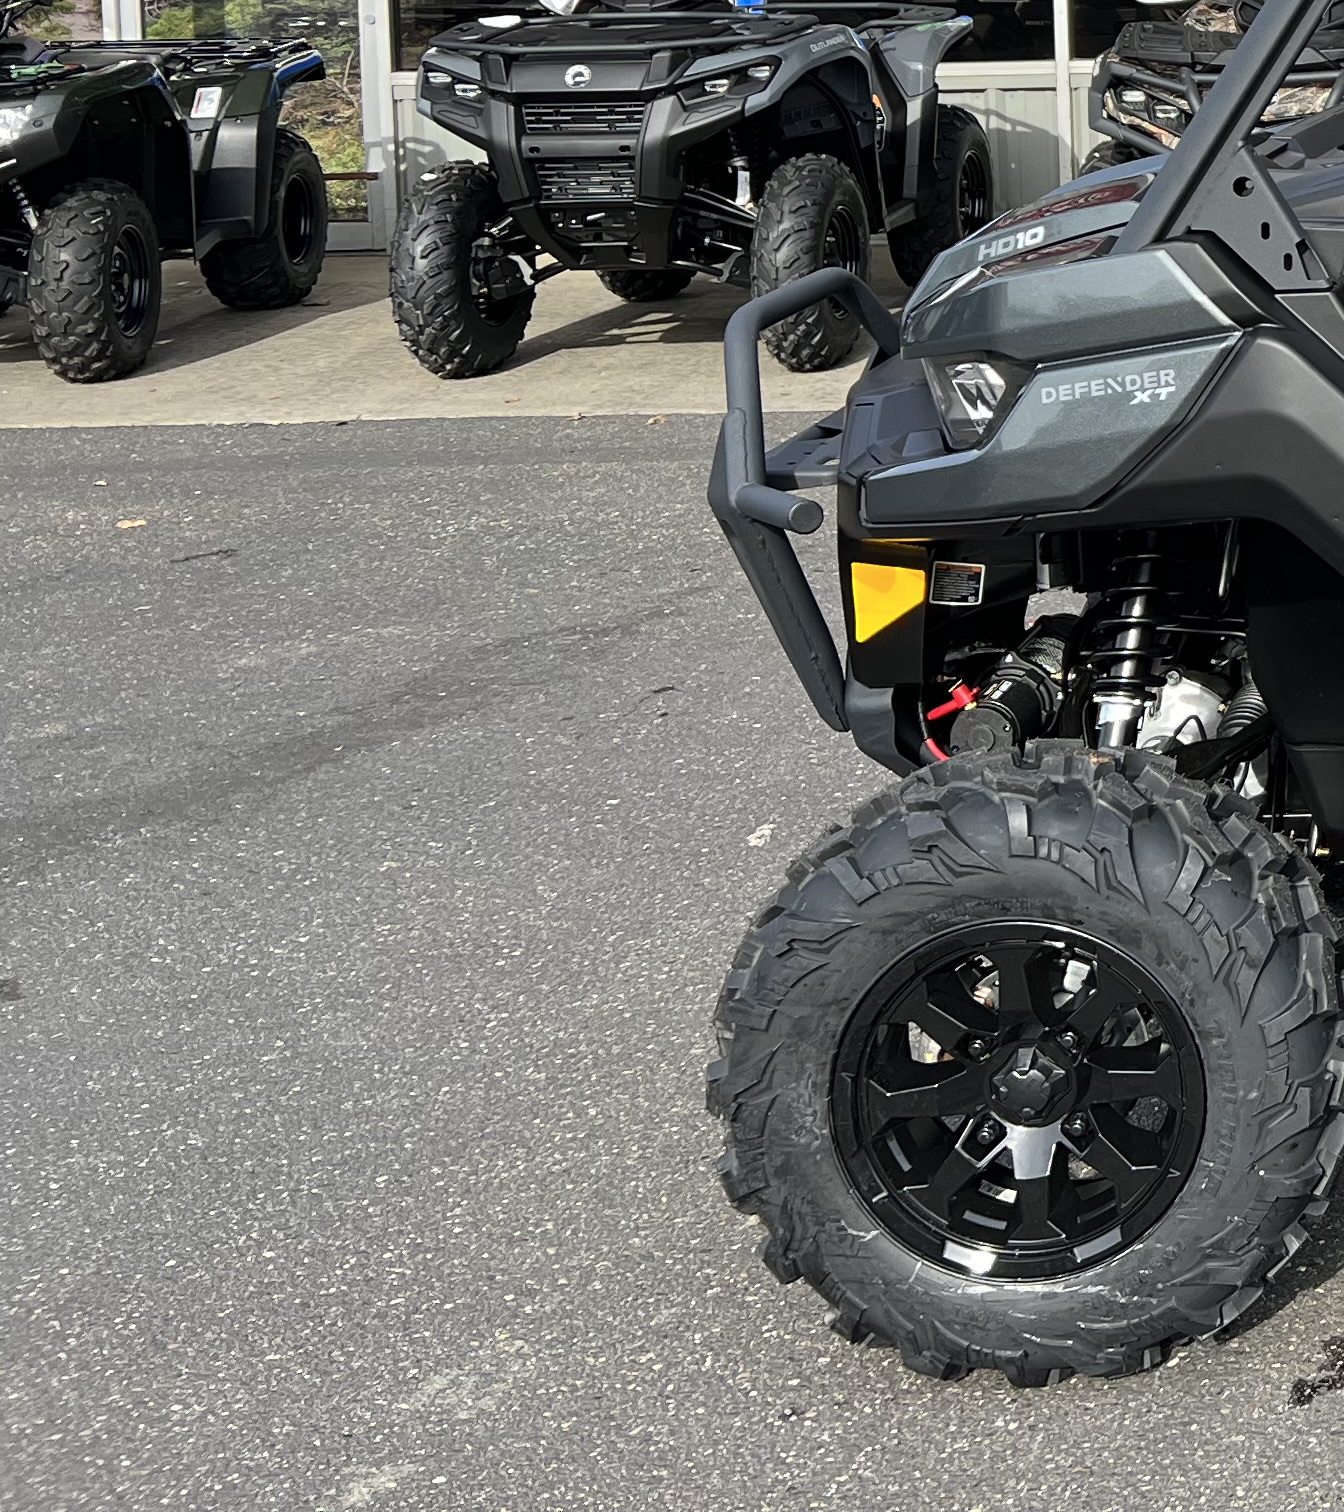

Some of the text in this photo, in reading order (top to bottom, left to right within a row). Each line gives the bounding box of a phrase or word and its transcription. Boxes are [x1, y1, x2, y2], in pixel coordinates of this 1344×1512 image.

[977, 225, 1046, 262] HD10
[1040, 368, 1177, 405] DEFENDER
[1129, 386, 1177, 405] XT
